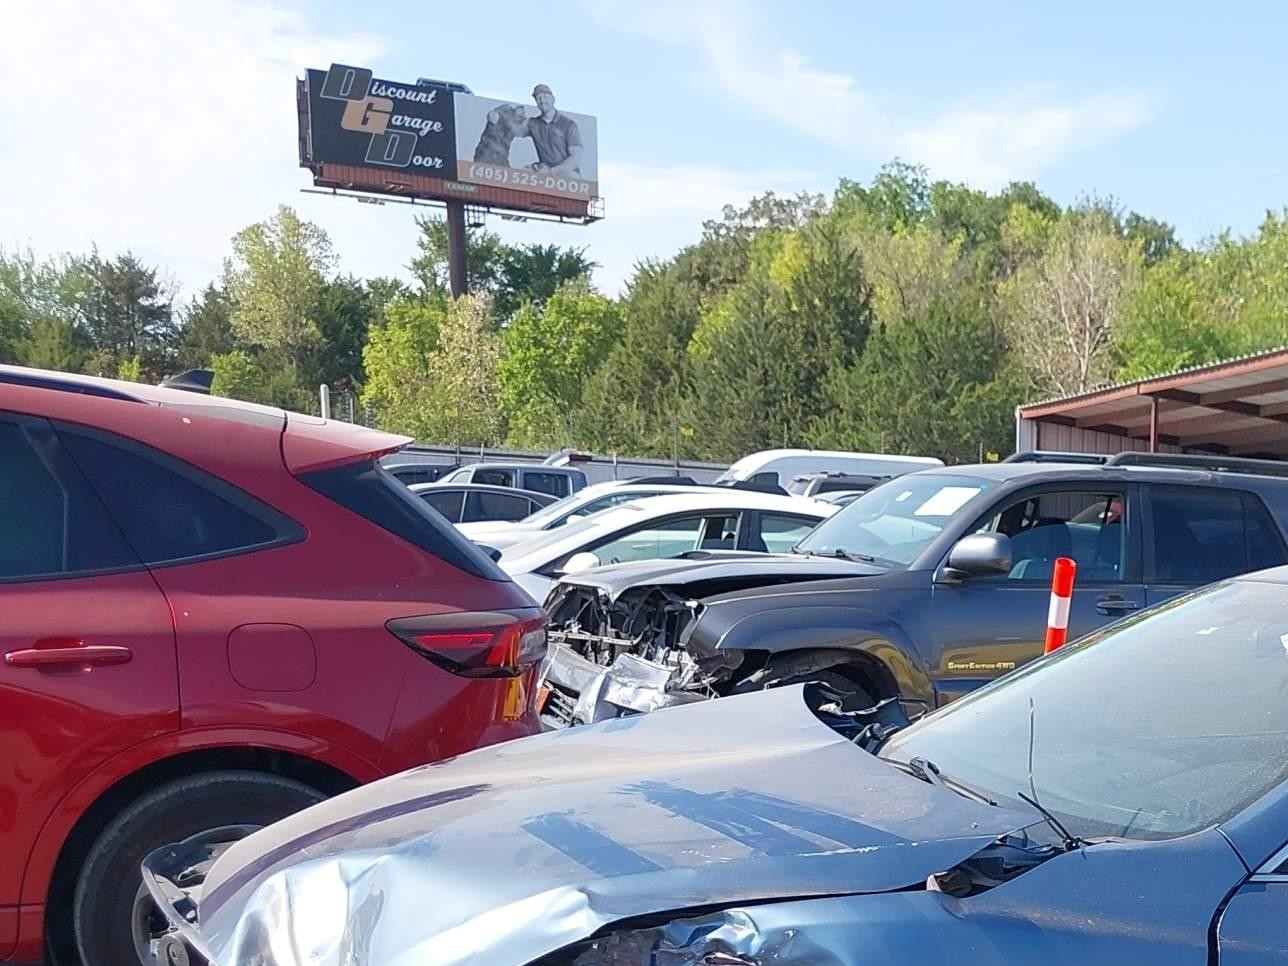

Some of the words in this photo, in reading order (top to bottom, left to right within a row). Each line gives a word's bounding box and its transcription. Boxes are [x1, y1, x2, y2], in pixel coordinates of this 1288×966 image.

[320, 63, 438, 104] Discount
[341, 95, 444, 136] Garage
[364, 128, 444, 168] Door
[469, 164, 508, 184] (405)
[511, 171, 591, 195] 525-DOOR
